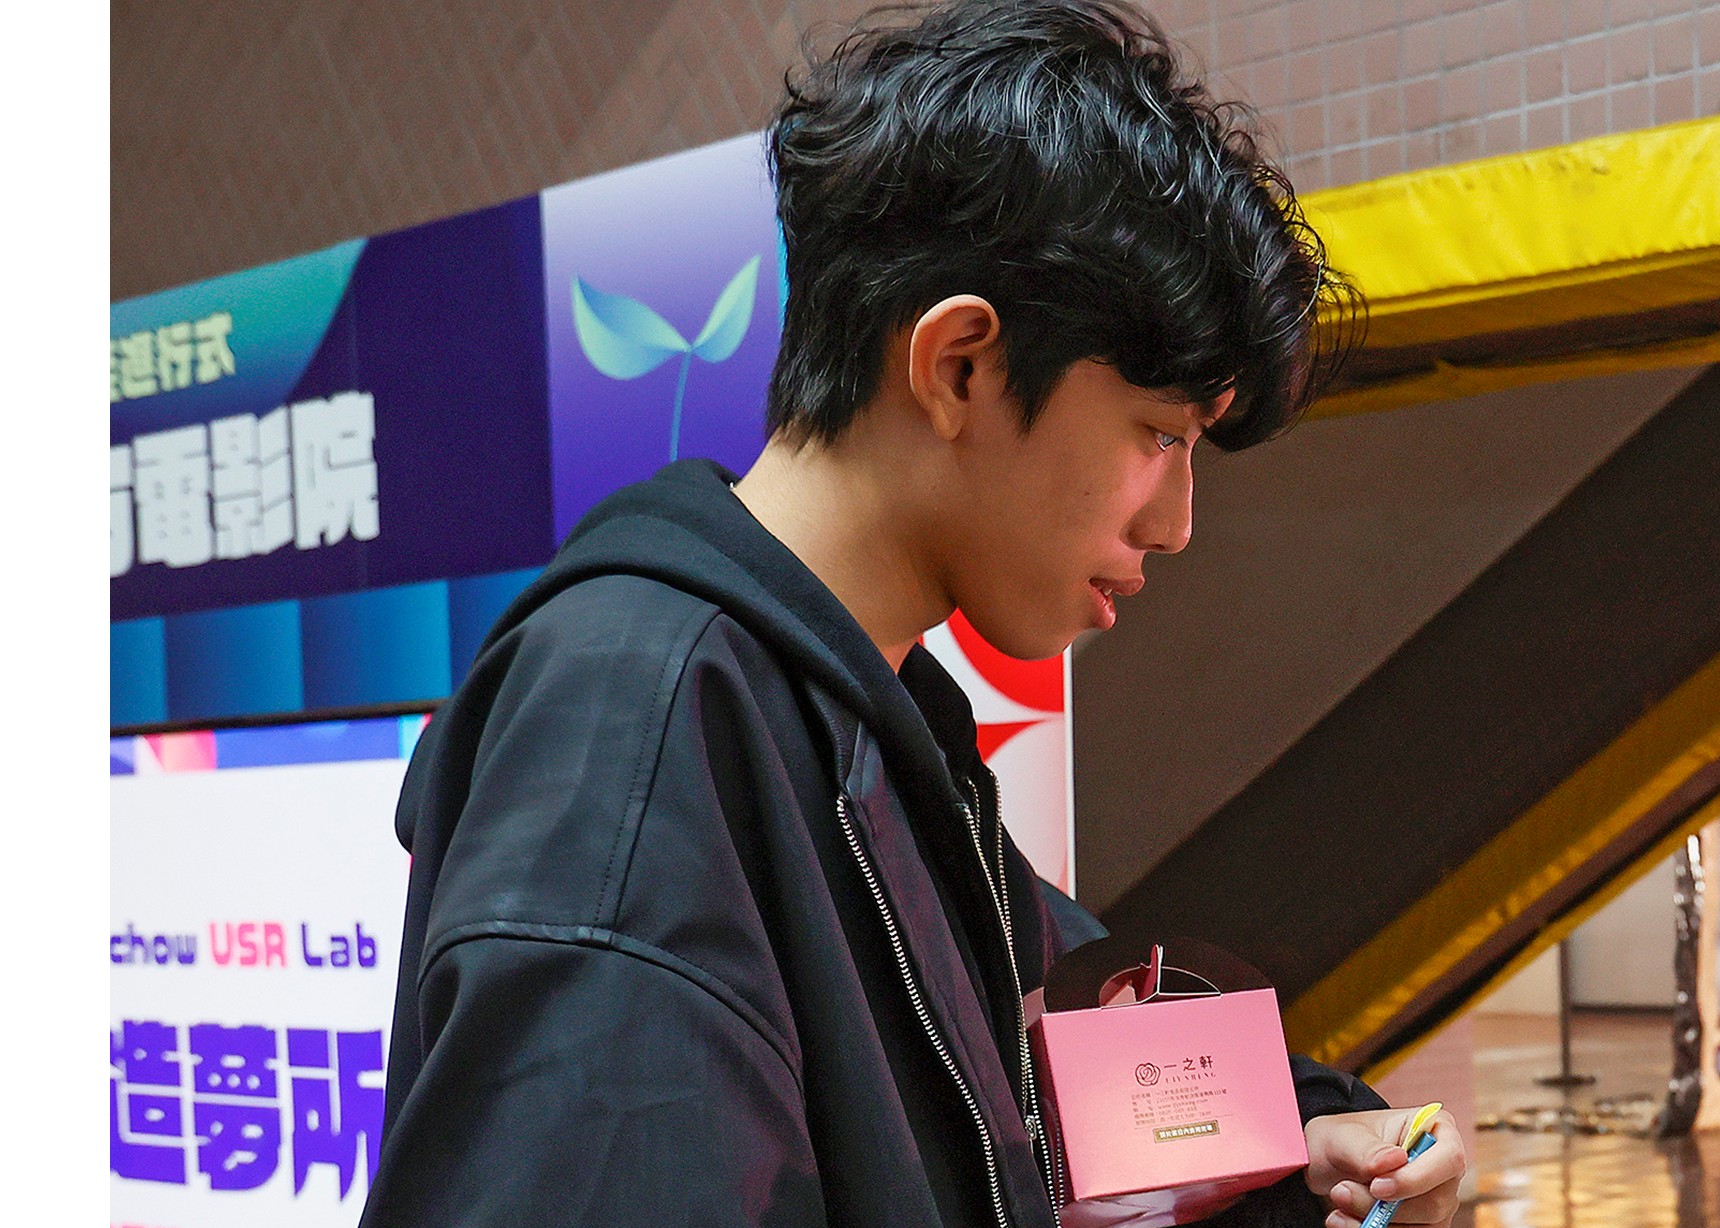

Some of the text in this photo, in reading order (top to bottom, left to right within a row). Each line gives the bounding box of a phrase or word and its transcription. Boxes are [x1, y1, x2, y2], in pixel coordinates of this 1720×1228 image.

[209, 922, 287, 967] USR
[300, 923, 377, 968] Lab
[1164, 1055, 1214, 1072] 一之軒
